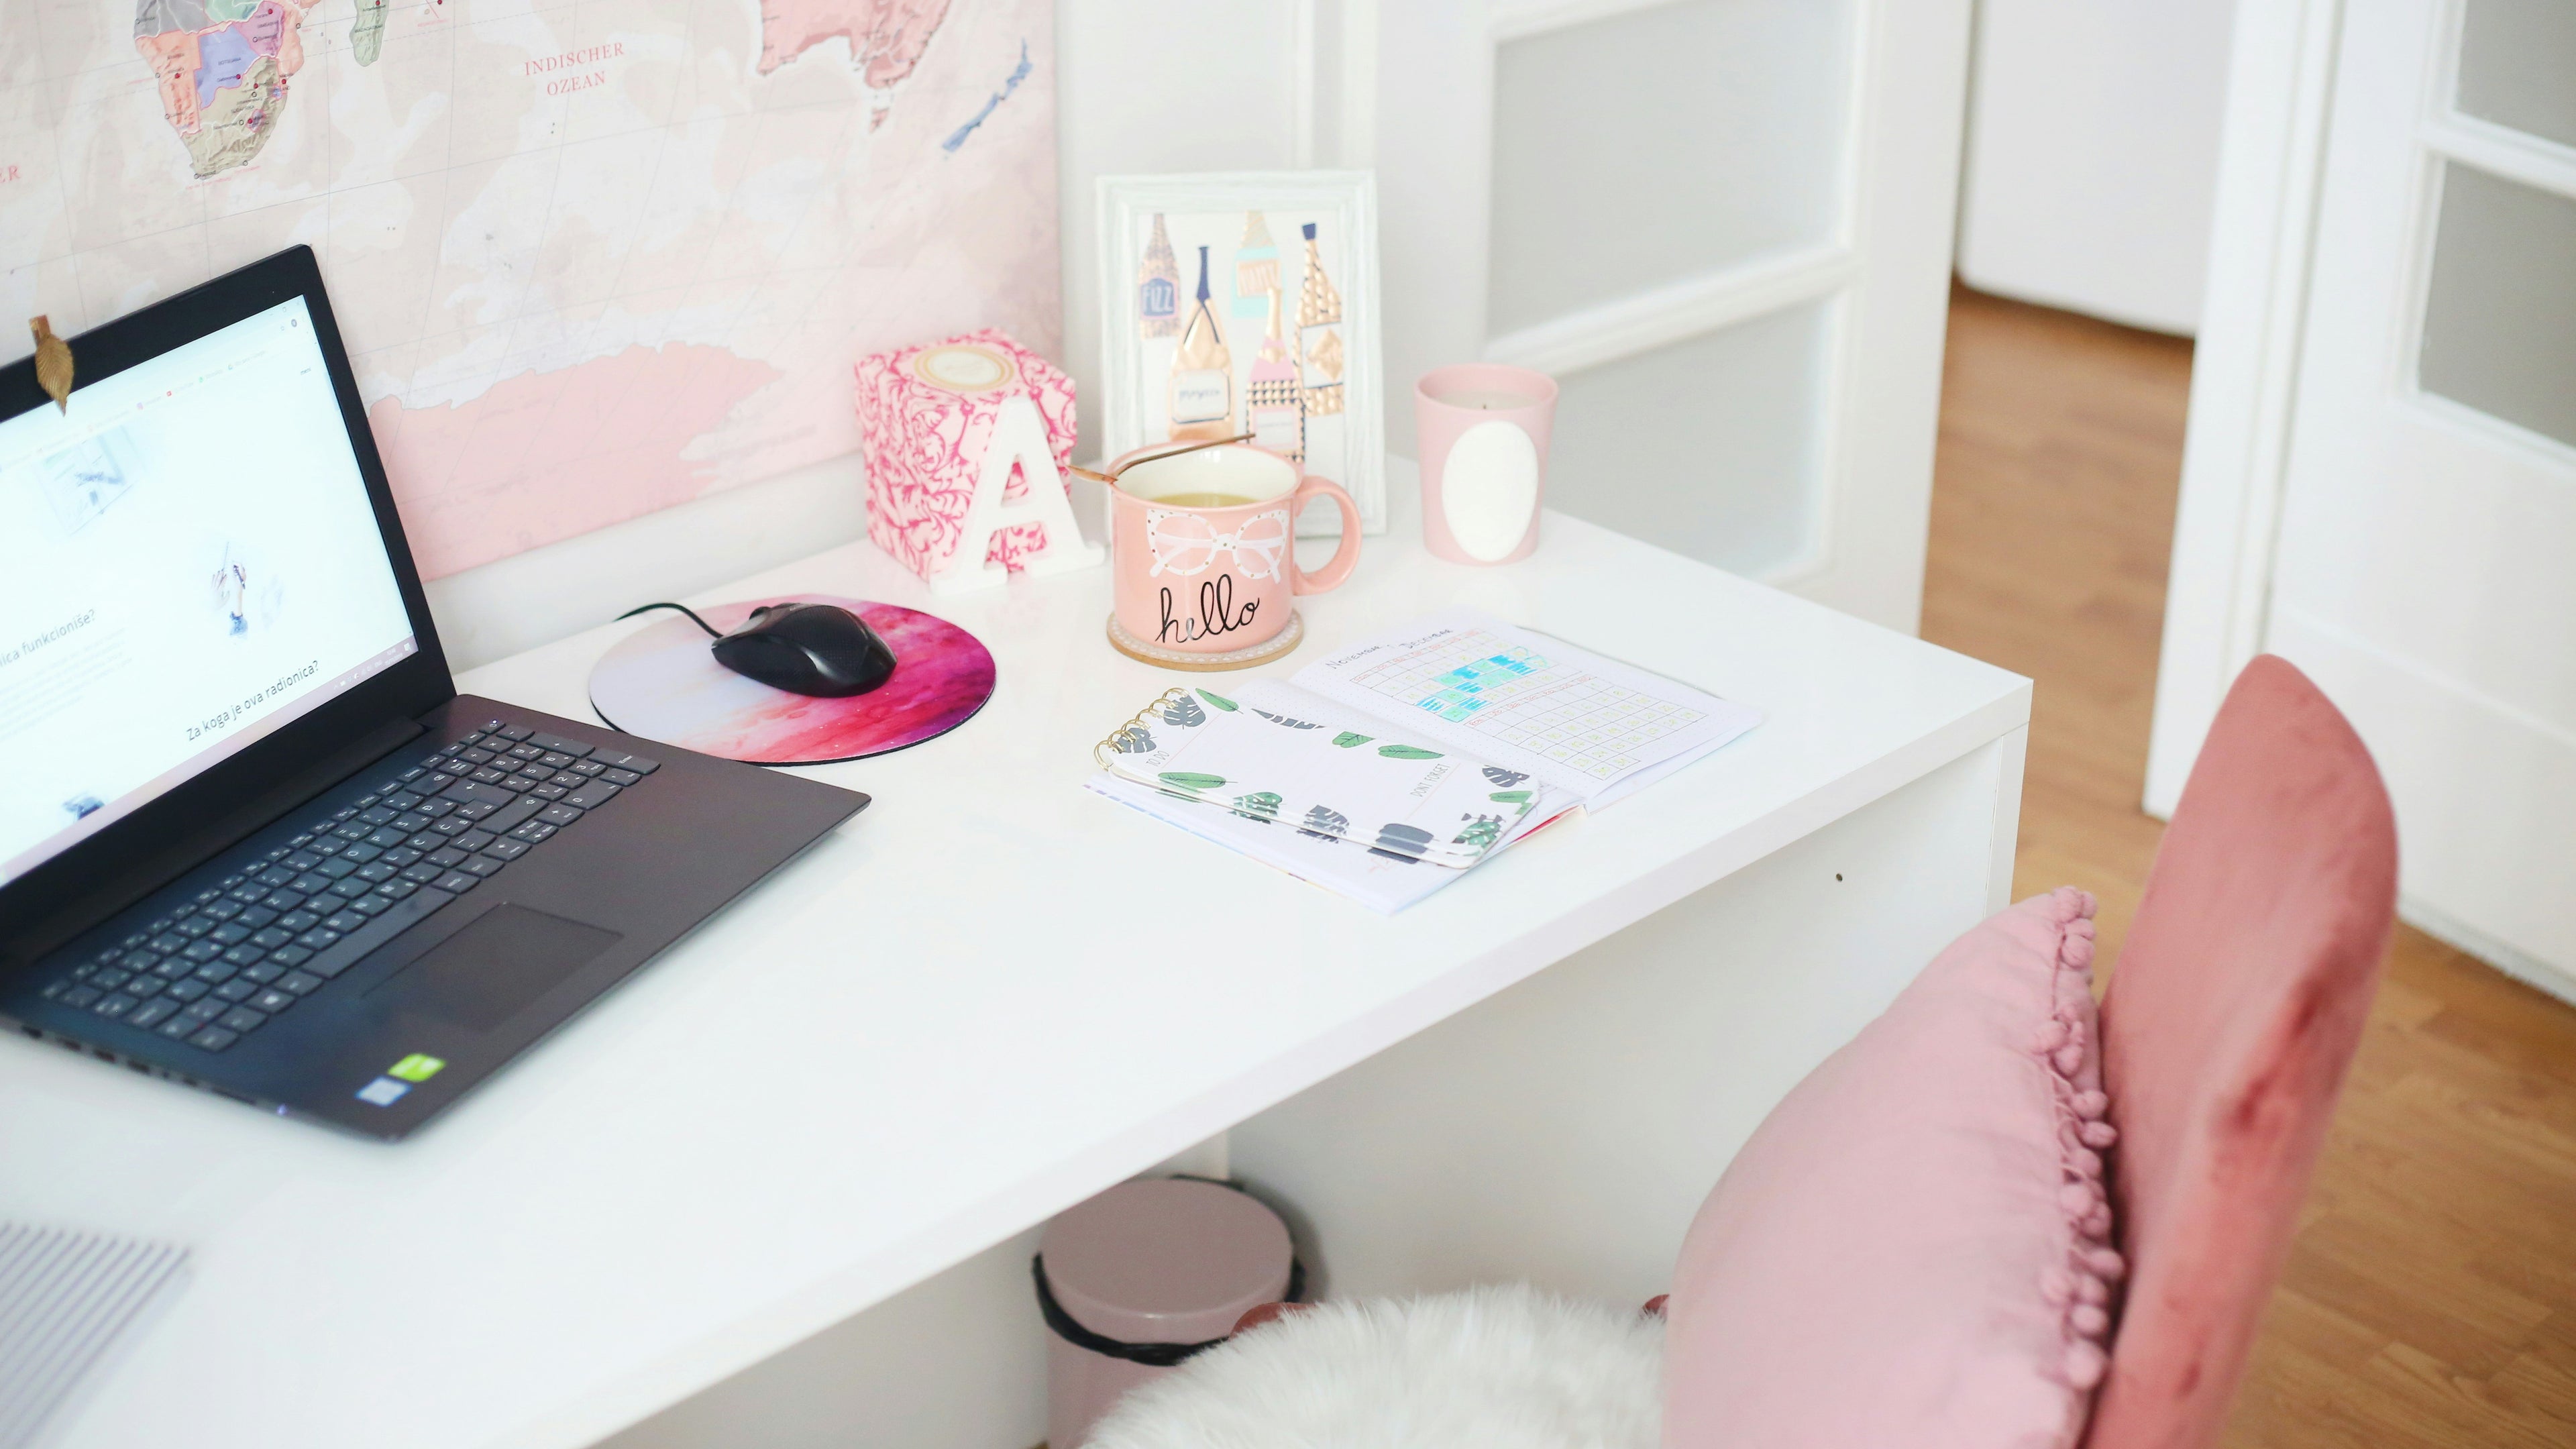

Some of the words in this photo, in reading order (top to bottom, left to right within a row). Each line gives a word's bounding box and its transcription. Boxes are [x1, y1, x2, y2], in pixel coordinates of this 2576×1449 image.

[525, 42, 625, 75] INDISCHER
[547, 70, 606, 96] OZEAN
[1154, 573, 1260, 644] hello
[22, 608, 96, 655] funkcioniše?
[186, 725, 202, 741] Za
[201, 708, 230, 729] koga
[231, 704, 242, 721] je
[244, 692, 264, 710] ova
[265, 660, 319, 698] radionica?
[1145, 758, 1161, 767] TO
[1153, 750, 1170, 760] DO
[1410, 782, 1433, 798] DONT
[1424, 763, 1451, 782] FORGET
